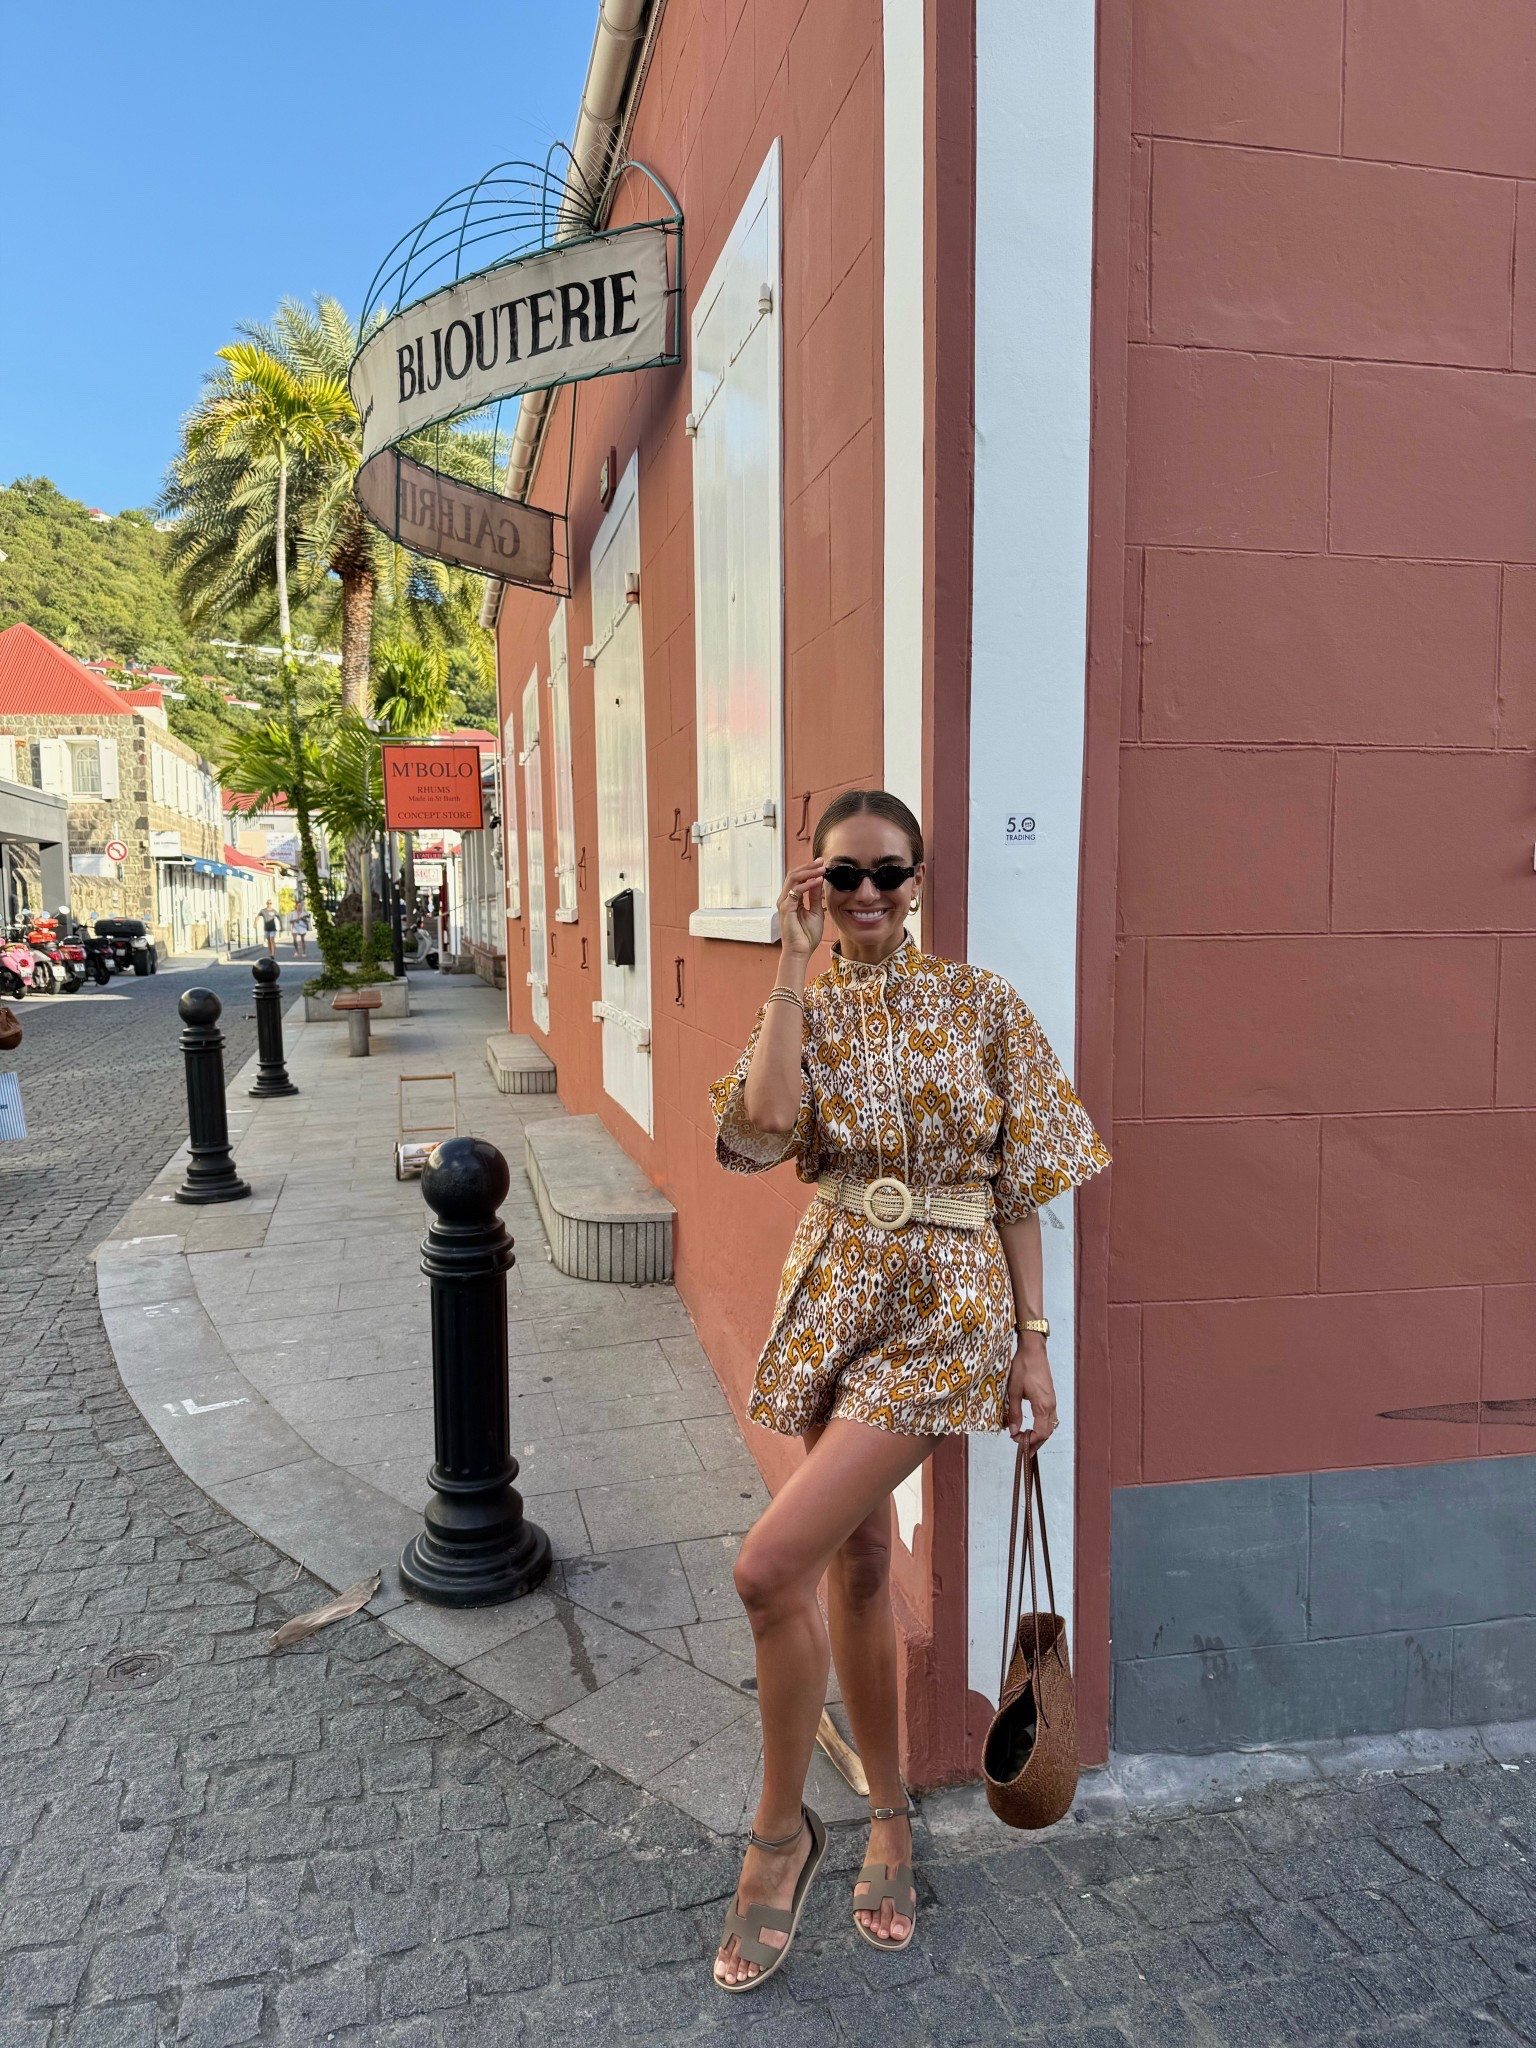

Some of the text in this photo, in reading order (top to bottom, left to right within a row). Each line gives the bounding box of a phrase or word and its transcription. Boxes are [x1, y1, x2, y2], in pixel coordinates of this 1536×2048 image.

[396, 270, 640, 403] BIJOUTERIE
[392, 762, 473, 778] M'BOLO
[417, 786, 451, 794] RHUMS
[397, 811, 472, 820] CONCEPT STORE
[1006, 817, 1036, 833] 5.0
